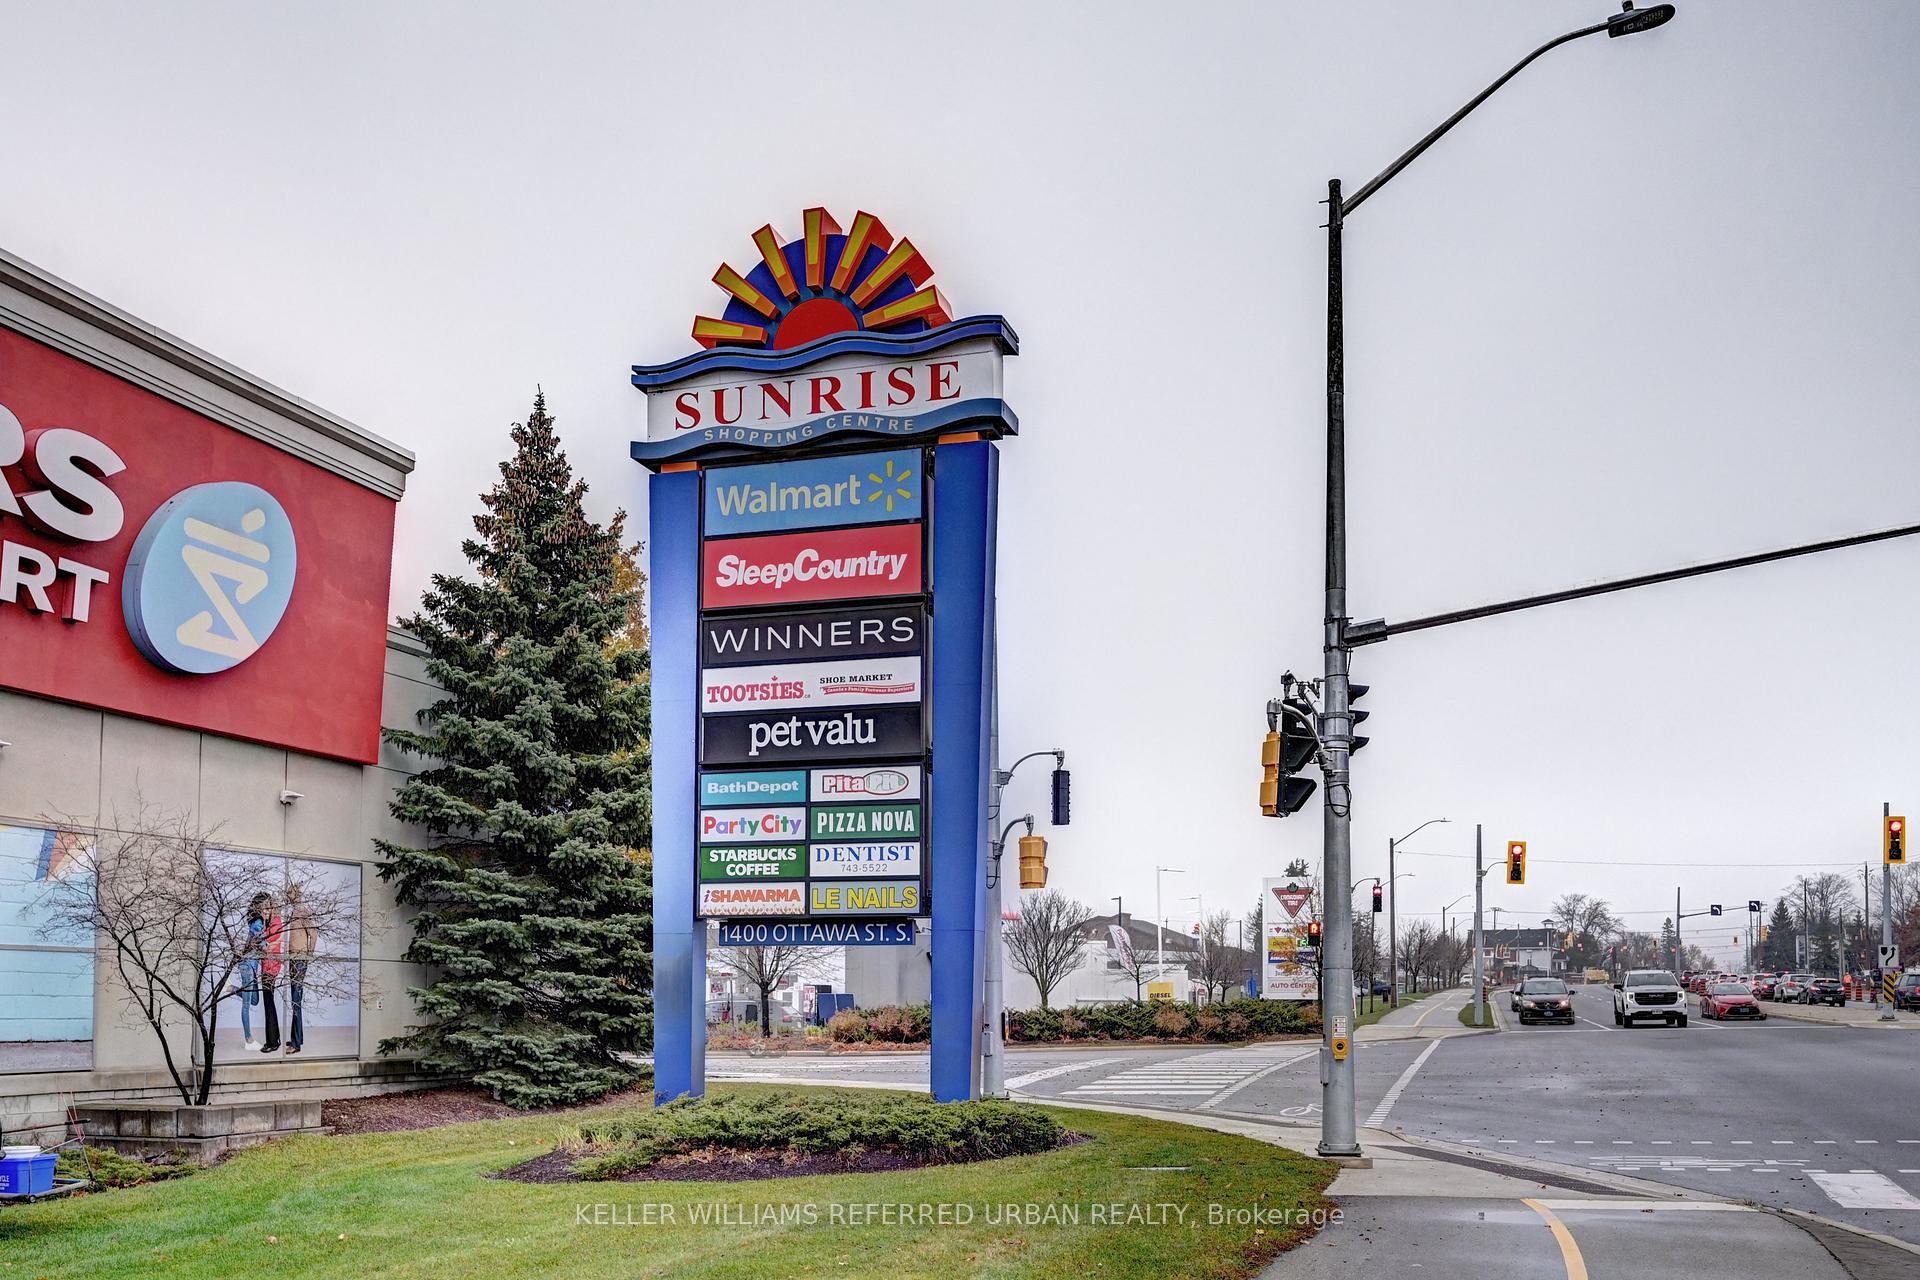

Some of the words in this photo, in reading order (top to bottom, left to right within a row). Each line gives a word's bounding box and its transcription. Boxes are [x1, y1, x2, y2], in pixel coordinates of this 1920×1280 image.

[674, 361, 962, 431] SUNRISE
[704, 425, 813, 444] SHOPPING
[826, 413, 915, 430] CENTRE
[716, 474, 861, 517] Walmart
[710, 616, 915, 654] WINNERS
[819, 676, 846, 684] SHOE
[849, 673, 893, 683] MARKET
[748, 715, 801, 756] pet
[806, 713, 876, 746] valu
[822, 774, 865, 793] Pita
[817, 812, 866, 834] PIZZA
[872, 810, 915, 832] NOVA
[709, 848, 797, 862] STARBUCKS
[816, 845, 915, 862] DENTIST
[726, 863, 780, 876] COFFEE
[812, 888, 840, 910] LE
[846, 886, 919, 909] NAILS
[721, 925, 768, 943] 1400
[772, 924, 860, 942] OTTAWA
[864, 924, 890, 941] ST.
[896, 924, 911, 941] S.
